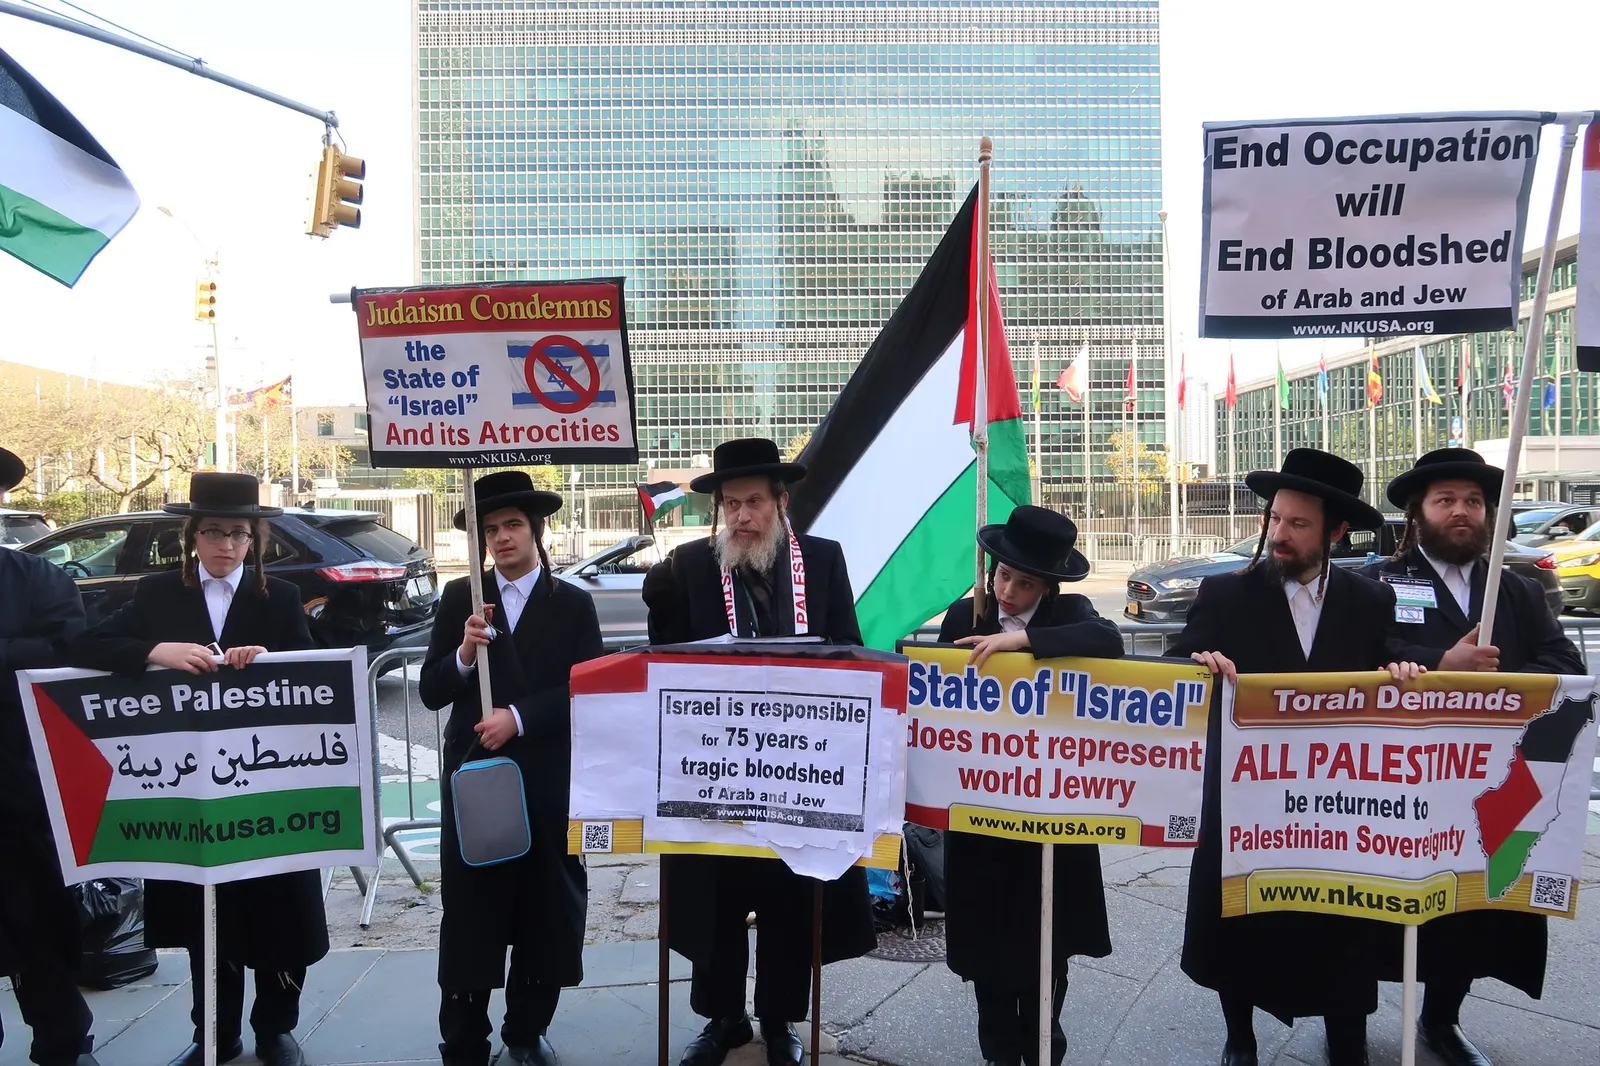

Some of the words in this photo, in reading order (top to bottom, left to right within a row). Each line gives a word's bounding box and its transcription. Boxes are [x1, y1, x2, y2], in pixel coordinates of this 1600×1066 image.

[1213, 133, 1289, 170] End
[1304, 127, 1535, 172] Occupation
[1335, 183, 1406, 217] will
[1217, 238, 1294, 272] End
[1308, 230, 1512, 270] Bloodshed
[365, 297, 465, 327] Judaism
[470, 293, 612, 321] Condemns
[1260, 289, 1288, 310] of
[1293, 287, 1353, 310] Arab
[1360, 287, 1405, 307] and
[1413, 284, 1468, 305] Jew
[1292, 318, 1435, 336] www.NKUSA.org
[404, 340, 446, 362] the
[382, 367, 446, 390] State
[451, 364, 480, 387] of
[385, 422, 435, 446] And
[440, 422, 470, 446] its
[478, 417, 620, 445] Atrocities
[448, 453, 552, 466] www.NKUSA.org
[80, 693, 162, 721] Free
[171, 679, 335, 712] Palestine
[665, 695, 721, 716] Israel
[727, 697, 744, 717] is
[750, 700, 866, 723] responsible
[908, 661, 1001, 713] State
[1012, 669, 1051, 716] of
[1060, 671, 1204, 728] "Israel"
[1273, 687, 1365, 712] Torah
[1376, 685, 1522, 711] Demands
[701, 733, 719, 747] for
[725, 727, 749, 747] 75
[755, 731, 809, 752] years
[815, 738, 827, 752] of
[907, 717, 973, 752] does
[981, 729, 1040, 760] not
[1047, 735, 1202, 772] represent
[117, 744, 198, 790] عربية
[211, 731, 349, 788] فلسطين
[681, 756, 739, 781] tragic
[745, 757, 845, 786] bloodshed
[1231, 744, 1297, 783] ALL
[1306, 742, 1493, 785] PALESTINE
[698, 786, 713, 800] of
[718, 786, 755, 801] Arab
[759, 791, 787, 805] and
[792, 793, 825, 808] Jew
[958, 766, 1042, 798] world
[1048, 768, 1137, 808] Jewry
[717, 808, 804, 824] www.NKUSA.org
[1285, 790, 1308, 814] be
[1314, 792, 1406, 820] returned
[1413, 796, 1428, 821] to
[119, 808, 341, 845] www.nkusa.org
[969, 814, 1126, 839] www.NKUSA.org
[1230, 823, 1348, 853] Palestinian
[1356, 825, 1466, 860] Sovereignty
[1259, 884, 1447, 915] www.nkusa.org
